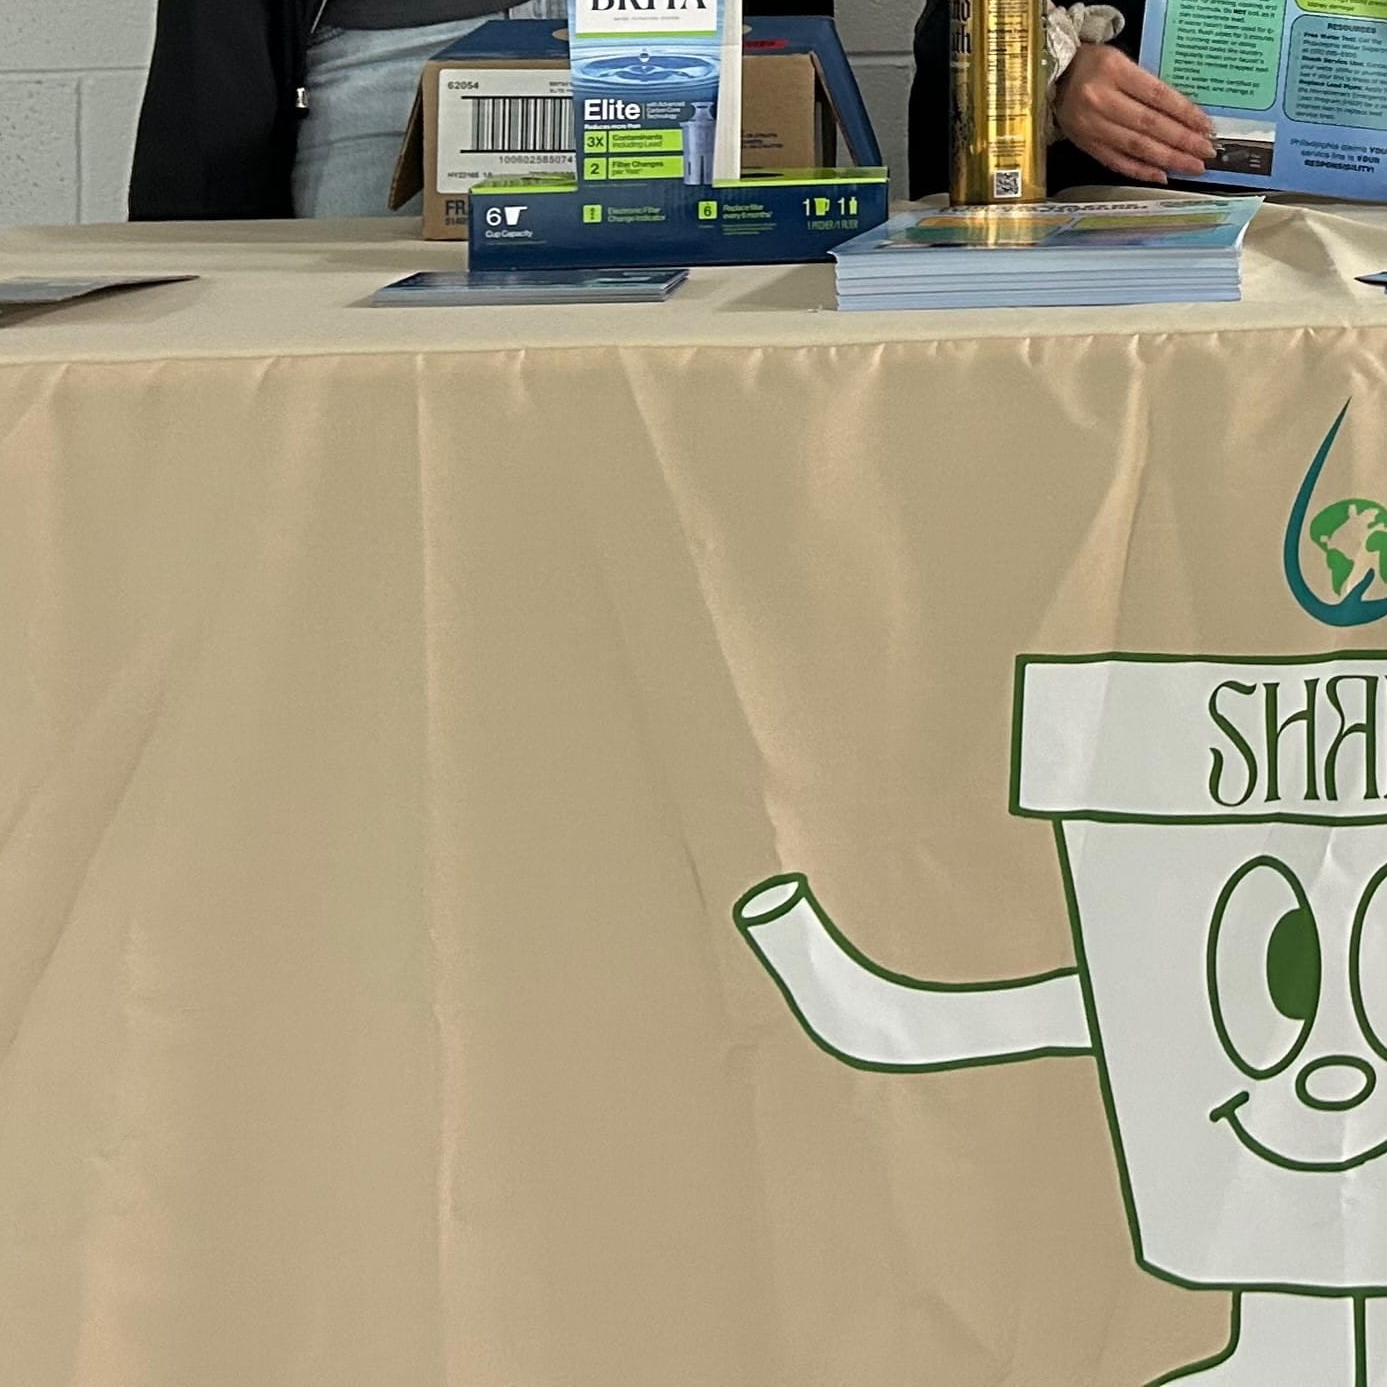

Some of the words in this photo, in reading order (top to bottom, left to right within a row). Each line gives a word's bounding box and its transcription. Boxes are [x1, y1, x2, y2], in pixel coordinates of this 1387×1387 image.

[447, 82, 479, 90] 62054
[584, 99, 641, 120] Elite
[586, 136, 604, 148] 3X
[499, 156, 576, 164] 100602585074
[1356, 155, 1380, 163] YOUR
[590, 163, 600, 174] 2
[632, 160, 664, 170] Changes
[704, 206, 712, 217] 6
[802, 198, 810, 216] 1
[837, 197, 845, 216] 1
[486, 207, 502, 226] 6
[485, 230, 500, 239] Cup
[502, 229, 533, 238] Capacity
